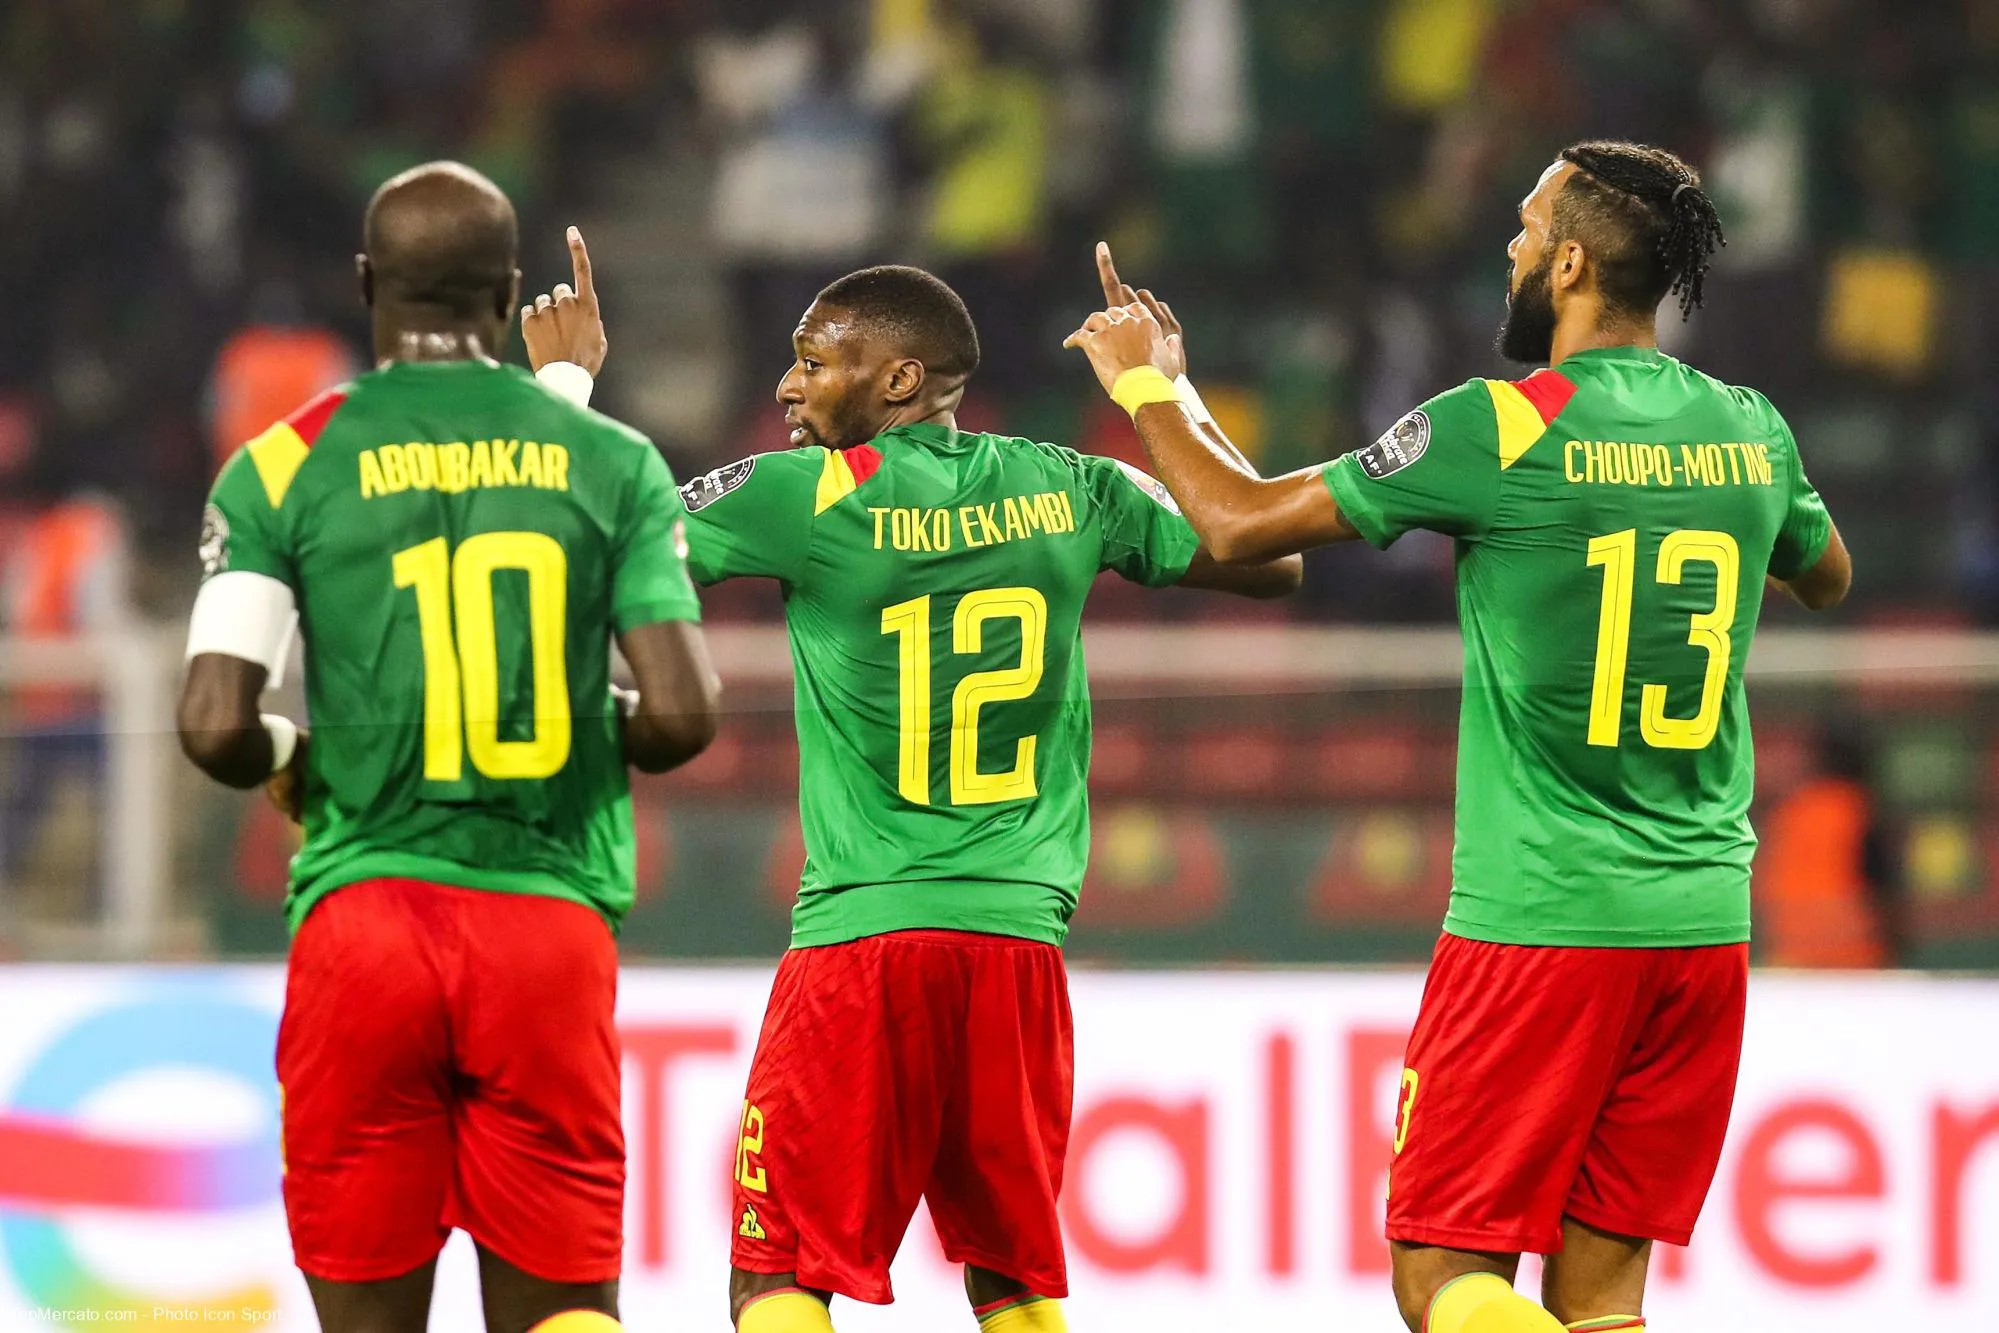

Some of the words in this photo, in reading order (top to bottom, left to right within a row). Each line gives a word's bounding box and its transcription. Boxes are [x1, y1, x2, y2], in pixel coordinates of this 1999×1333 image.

[358, 438, 569, 499] ABOUBAKAR
[867, 507, 950, 552] TOKO
[959, 490, 1075, 548] EKAMBI
[1564, 440, 1773, 487] CHOUPO-MOTING
[392, 530, 572, 781] 10
[880, 586, 1048, 806] 12
[1586, 528, 1740, 750] 13
